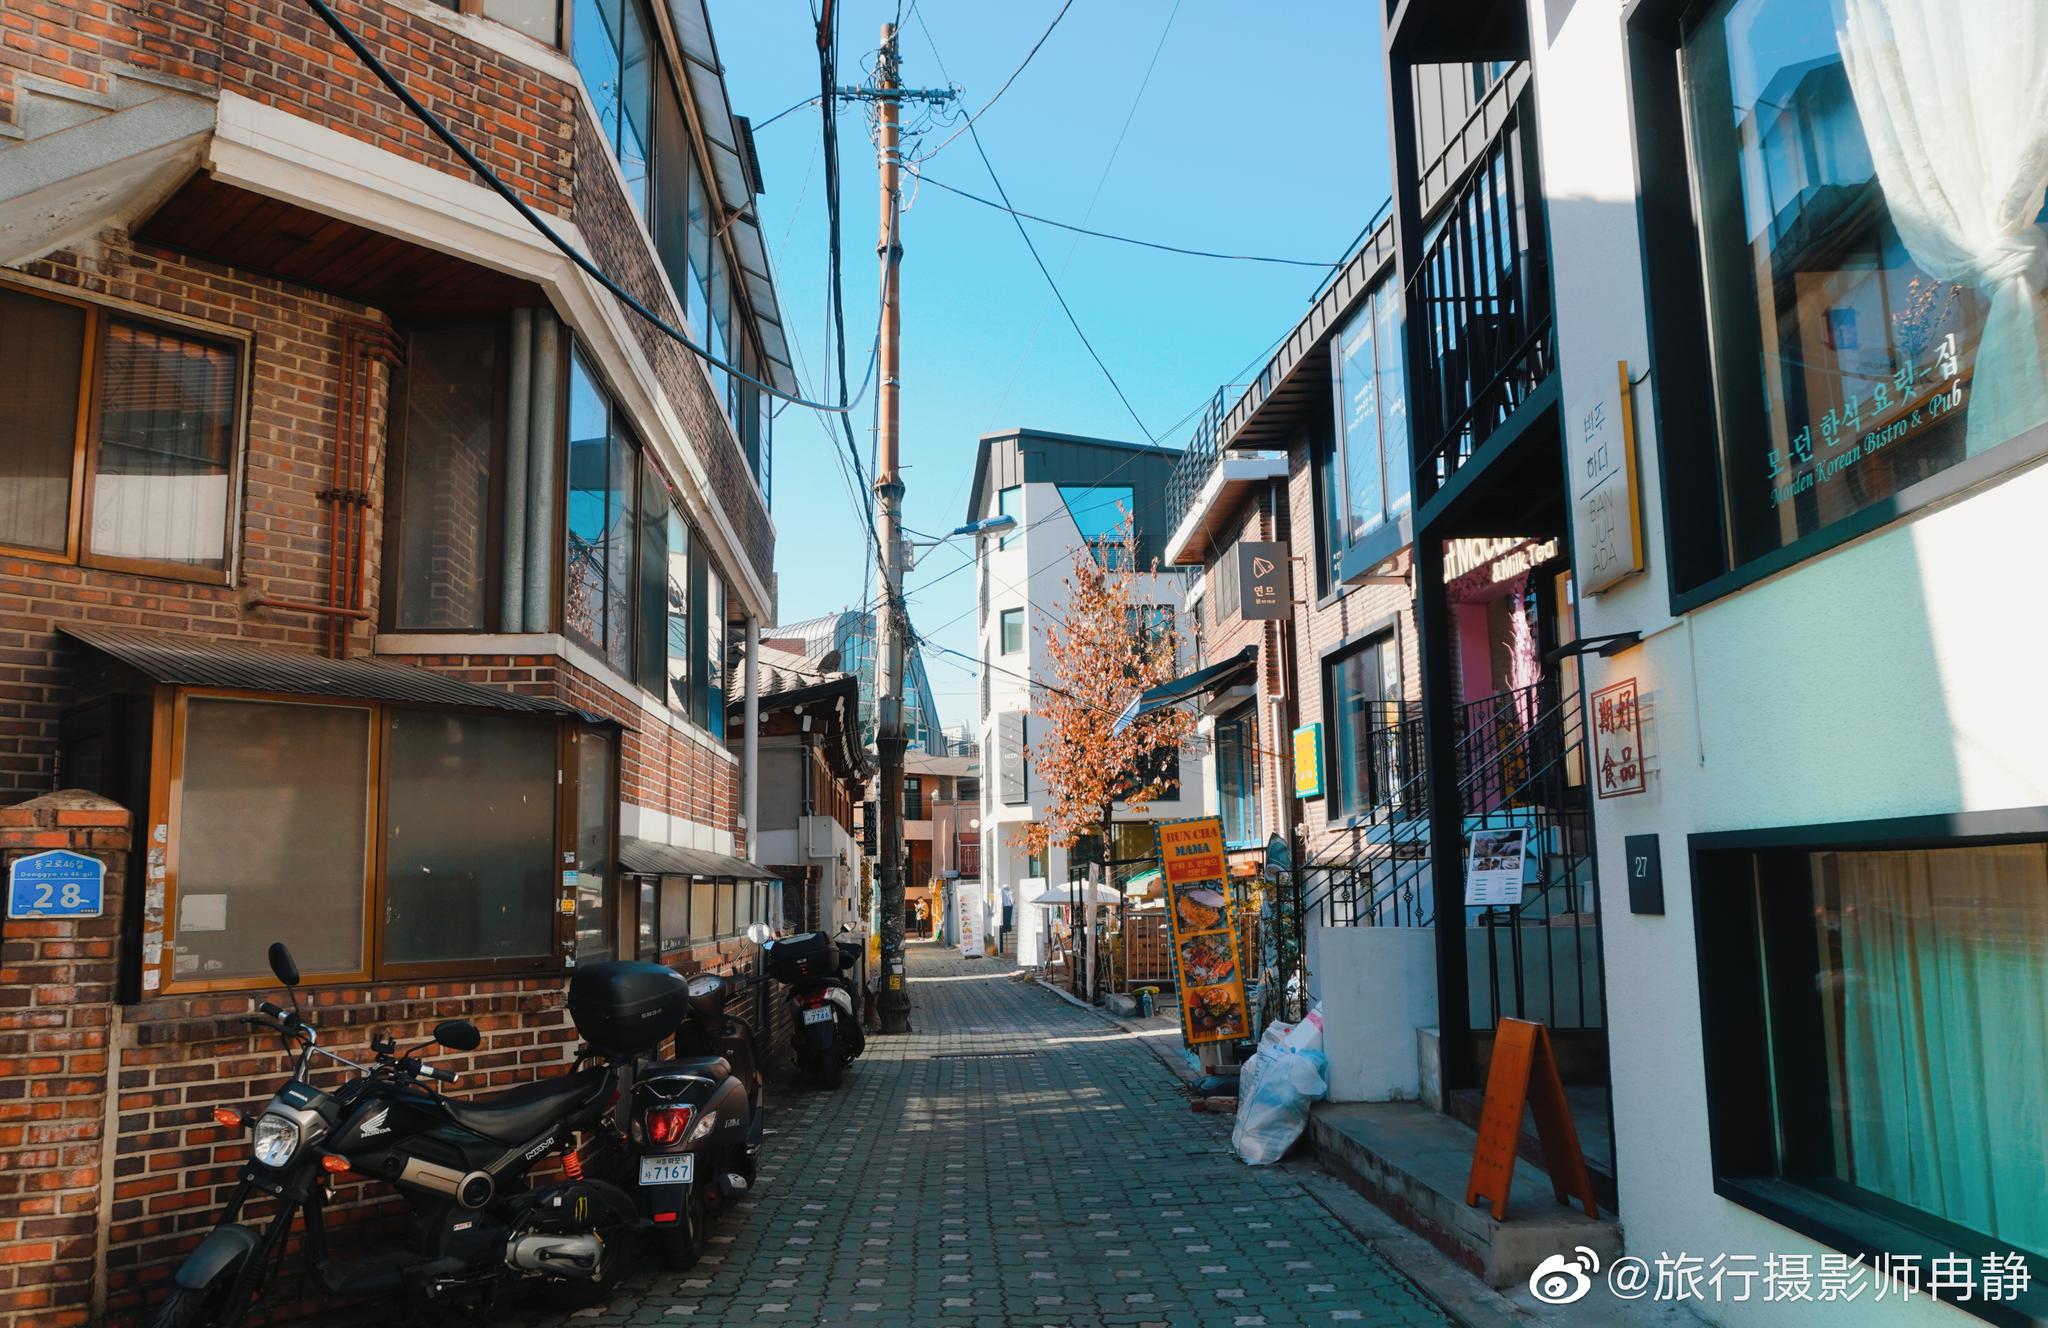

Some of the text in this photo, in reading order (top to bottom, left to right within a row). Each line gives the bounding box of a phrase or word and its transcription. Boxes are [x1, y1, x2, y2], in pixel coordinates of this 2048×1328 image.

[1816, 446, 1861, 482] Korean
[1863, 419, 1907, 454] Bistro
[1911, 409, 1922, 428] &
[1929, 379, 1962, 419] Pub
[1820, 395, 1860, 446] 한식
[1590, 488, 1613, 522] BAN
[1526, 540, 1558, 566] Tea
[1593, 544, 1617, 576] ADA
[1166, 827, 1218, 843] BUN CHA
[1175, 842, 1211, 856] MAMA
[1634, 856, 1648, 878] 27
[33, 883, 80, 908] 28
[361, 1127, 391, 1138] HONDA
[525, 1137, 555, 1160] NAVI
[654, 1165, 689, 1180] 7167
